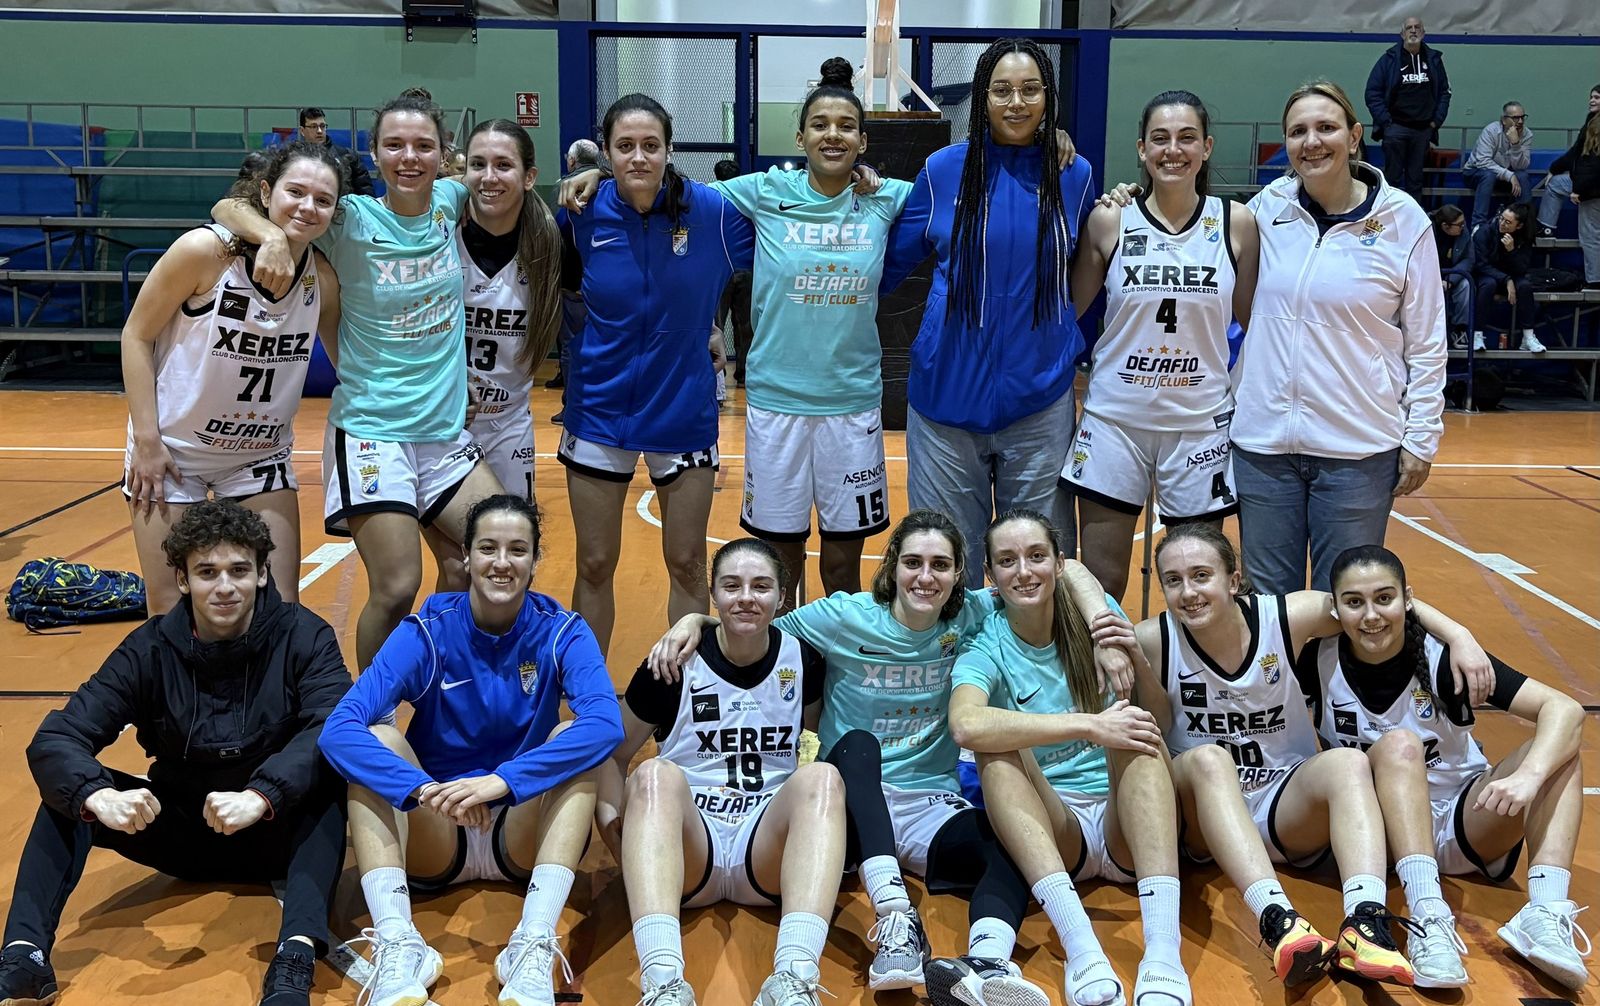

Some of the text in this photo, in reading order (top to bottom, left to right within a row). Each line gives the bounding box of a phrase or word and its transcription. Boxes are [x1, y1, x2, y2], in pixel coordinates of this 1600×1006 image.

[783, 221, 873, 245] XEREZ
[374, 246, 459, 285] XEREZ
[1122, 264, 1218, 288] XEREZ
[794, 275, 869, 291] DESAFIO
[1172, 286, 1219, 295] BALONCESTO
[803, 294, 858, 305] FIT CLUB
[464, 305, 527, 331] EREZ
[1156, 298, 1178, 334] 4
[213, 325, 310, 358] XEREZ
[484, 329, 527, 338] BALONCESTO
[211, 350, 309, 365] CLUB DEPORTIVO BALONCESTO
[1126, 355, 1199, 374] DESAFIO
[237, 366, 276, 402] 71
[1133, 375, 1190, 388] FIT CLUB
[240, 439, 274, 450] CLUB
[252, 462, 290, 493] 71
[843, 461, 886, 485] ASENCIO
[1211, 470, 1236, 506] 4
[855, 487, 885, 528] 15
[860, 660, 953, 689] XEREZ
[1184, 704, 1286, 735] XEREZ
[1240, 724, 1286, 739] BALONCESTO
[695, 725, 793, 753] XEREZ
[696, 752, 714, 760] CLUB
[724, 752, 764, 792] 19
